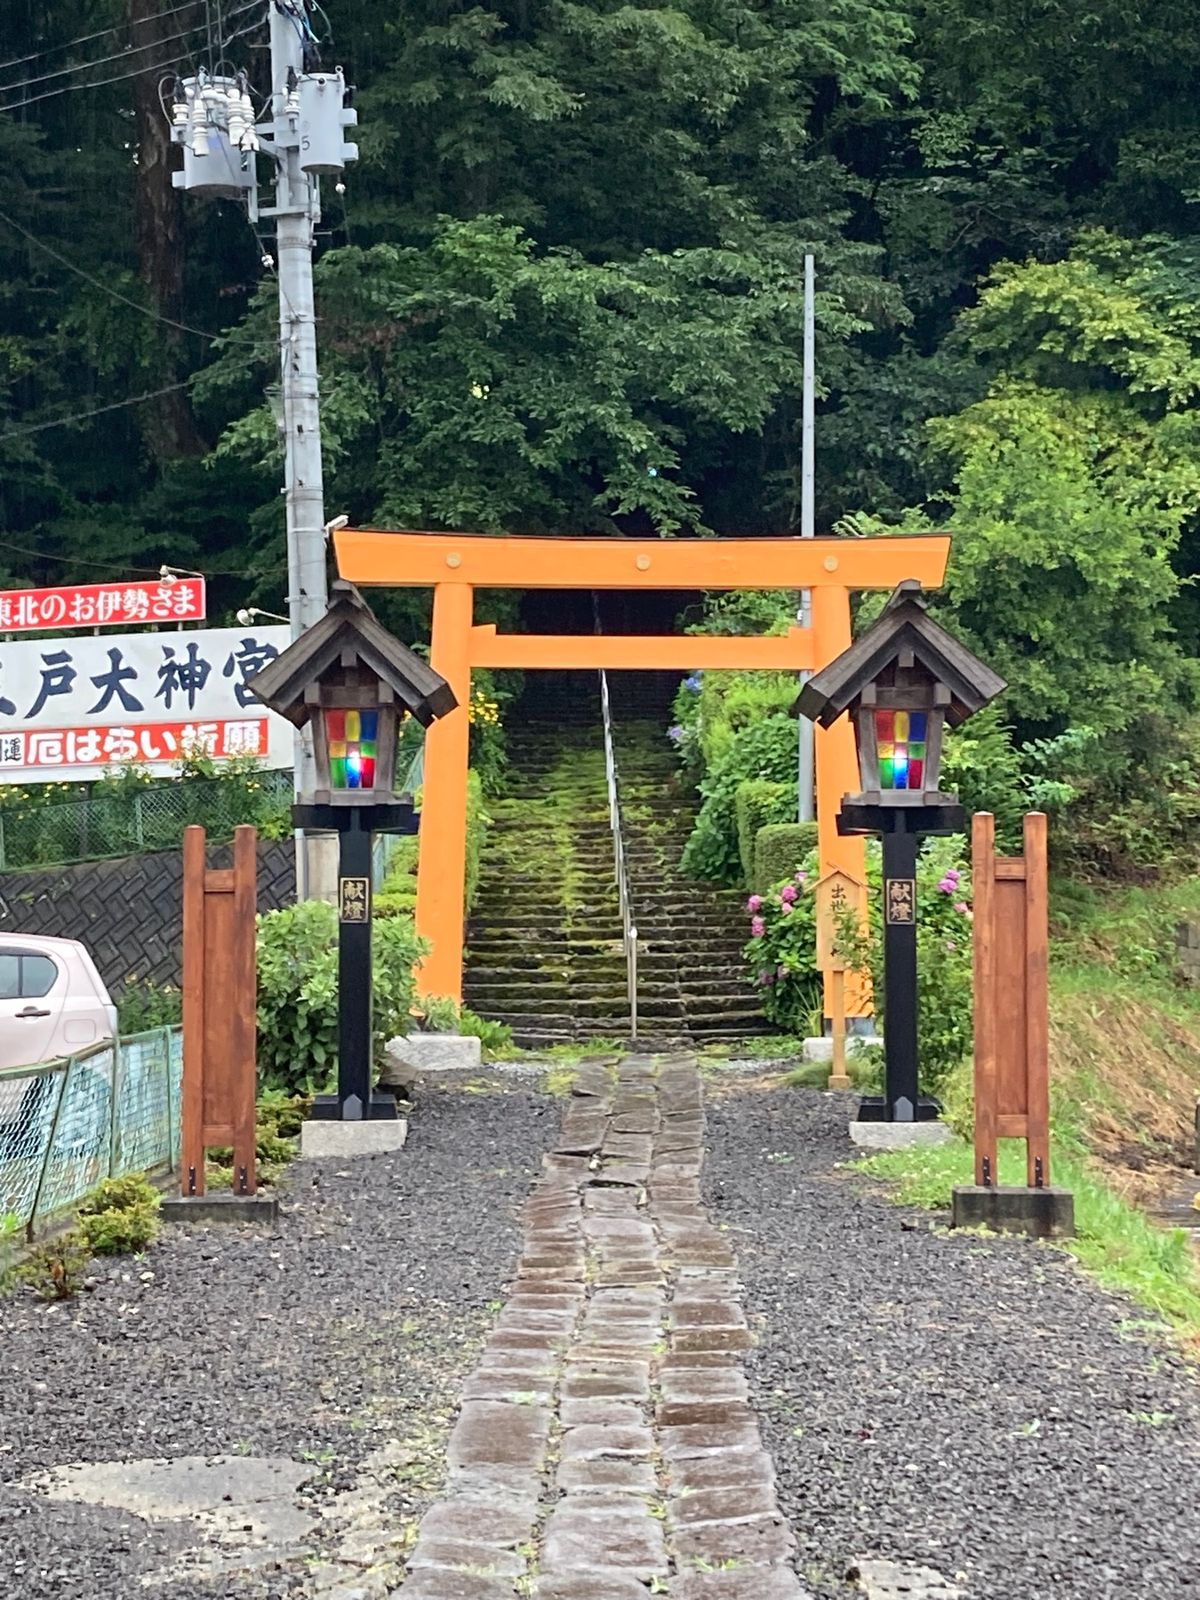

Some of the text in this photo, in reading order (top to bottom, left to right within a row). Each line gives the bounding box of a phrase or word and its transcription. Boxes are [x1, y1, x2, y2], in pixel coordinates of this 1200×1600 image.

[301, 135, 310, 151] 5
[0, 637, 279, 719] 戸大神宮
[0, 737, 22, 762] 運
[27, 721, 260, 764] 厄はらい祈願
